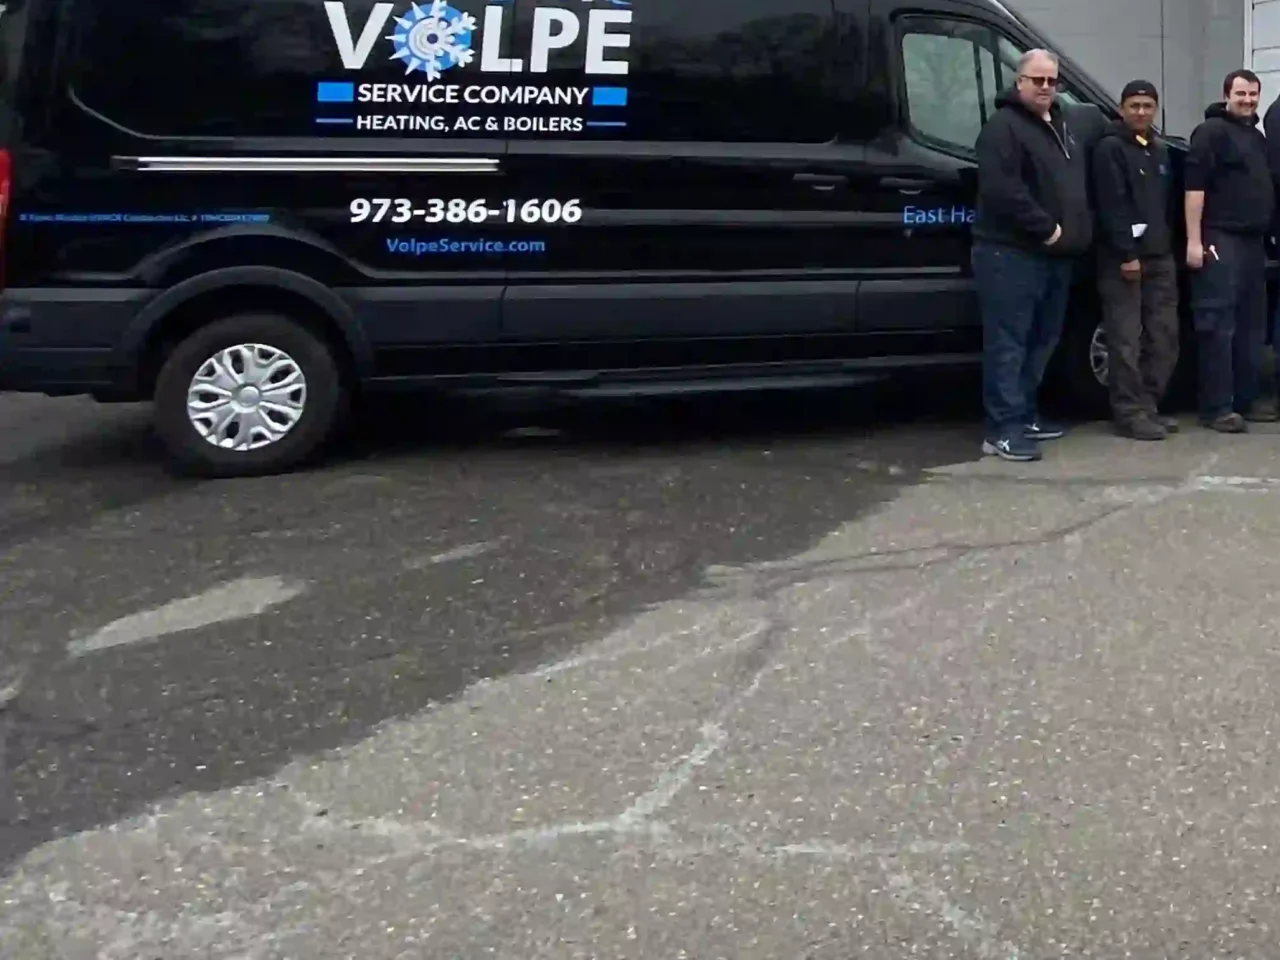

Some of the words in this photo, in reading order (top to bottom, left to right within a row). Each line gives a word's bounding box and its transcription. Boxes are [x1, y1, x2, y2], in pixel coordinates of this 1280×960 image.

[357, 84, 462, 104] SERVICE
[463, 85, 590, 105] COMPANY
[356, 115, 450, 132] HEATING,
[454, 117, 480, 131] AC
[484, 117, 499, 131] &
[504, 117, 583, 132] BOILERS
[349, 198, 583, 224] 973-386-1606
[904, 206, 945, 224] East
[386, 238, 546, 255] VolpeService.com
